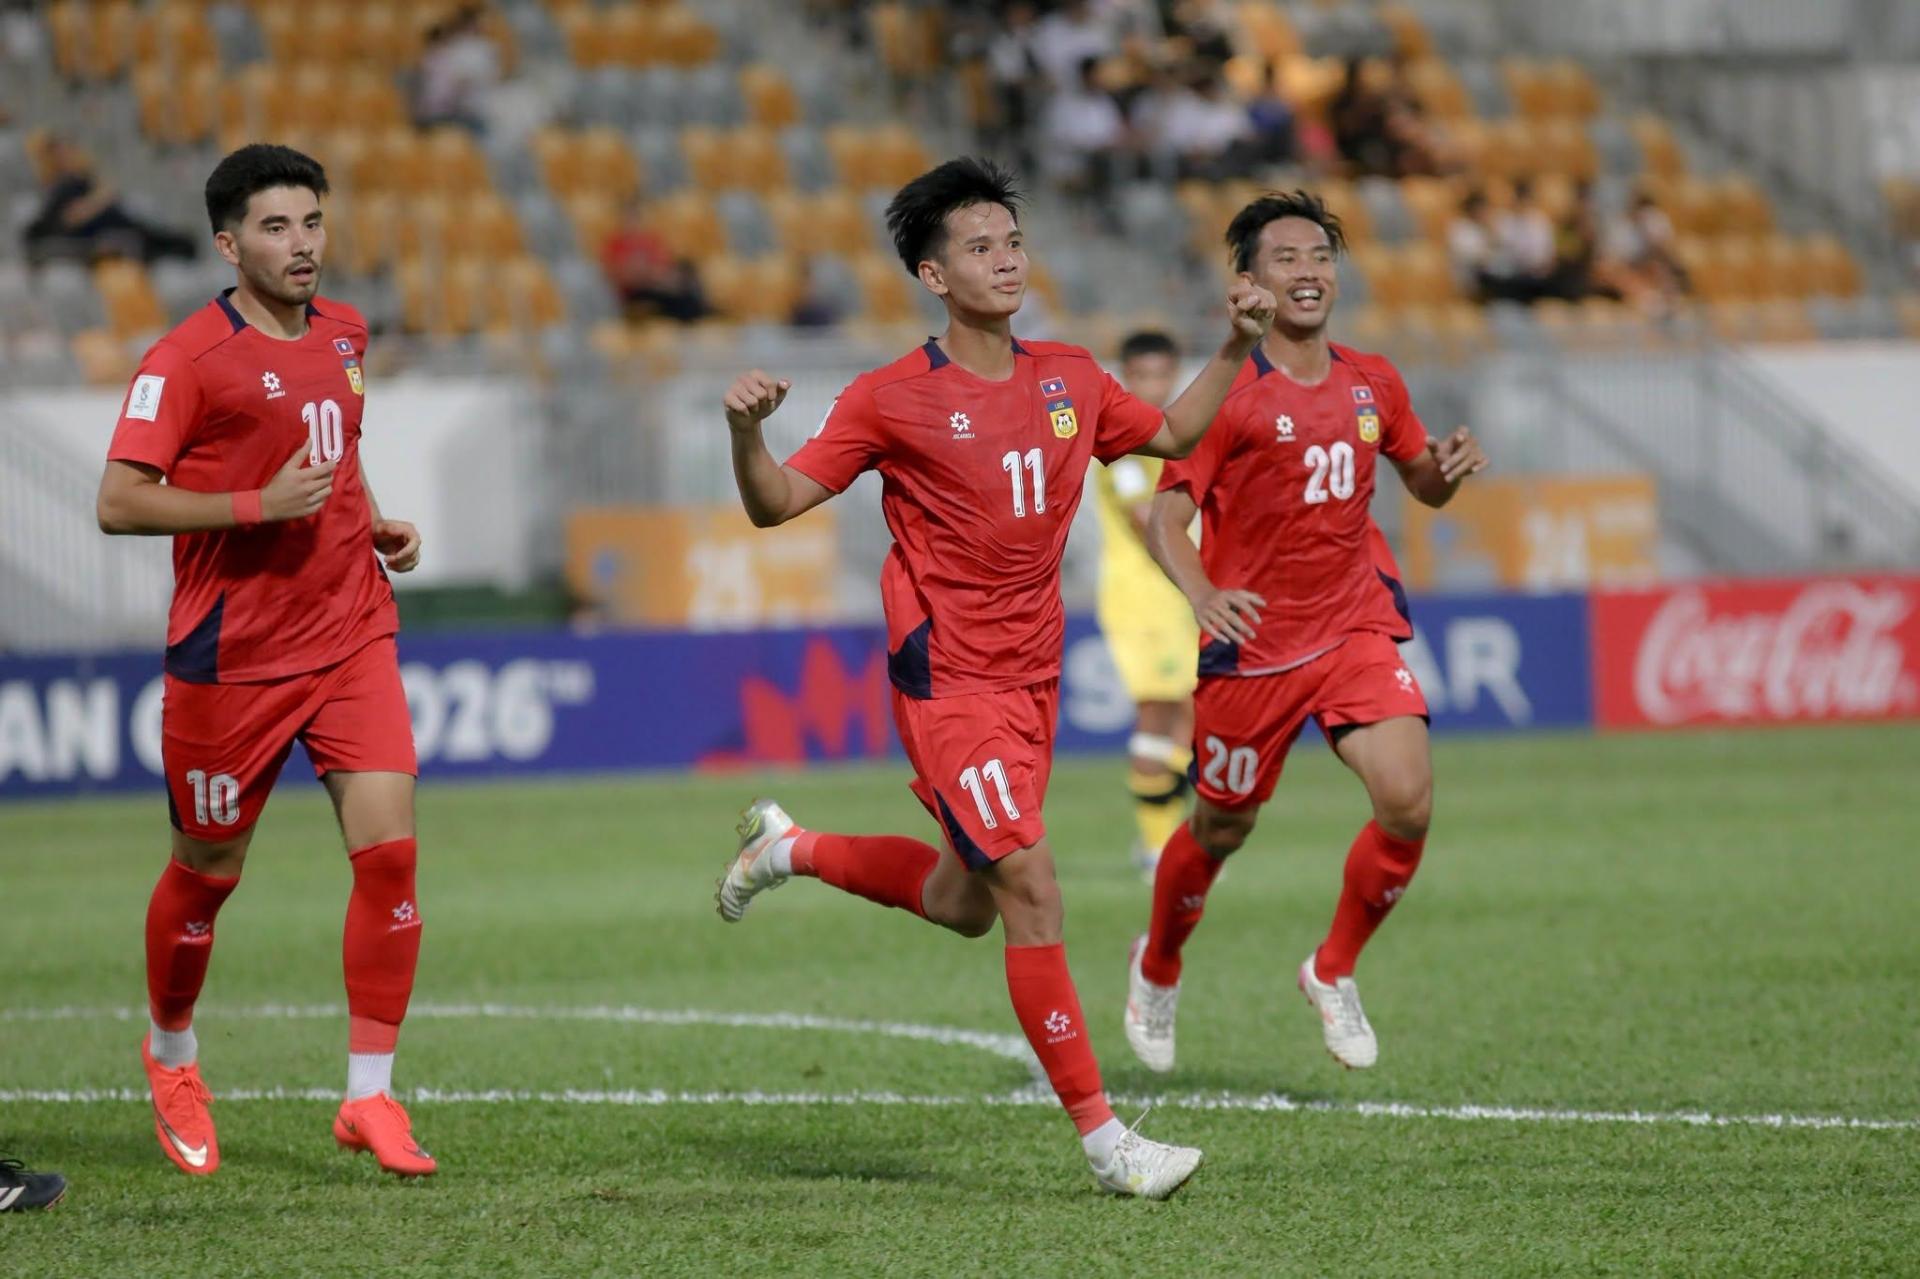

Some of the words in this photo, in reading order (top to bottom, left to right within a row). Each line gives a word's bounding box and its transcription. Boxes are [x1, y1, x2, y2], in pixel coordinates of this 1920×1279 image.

[301, 399, 344, 466] 10
[1002, 447, 1046, 518] 11
[1303, 440, 1356, 504] 20
[186, 768, 240, 826] 10
[959, 758, 1021, 830] 11
[1203, 735, 1259, 796] 20
